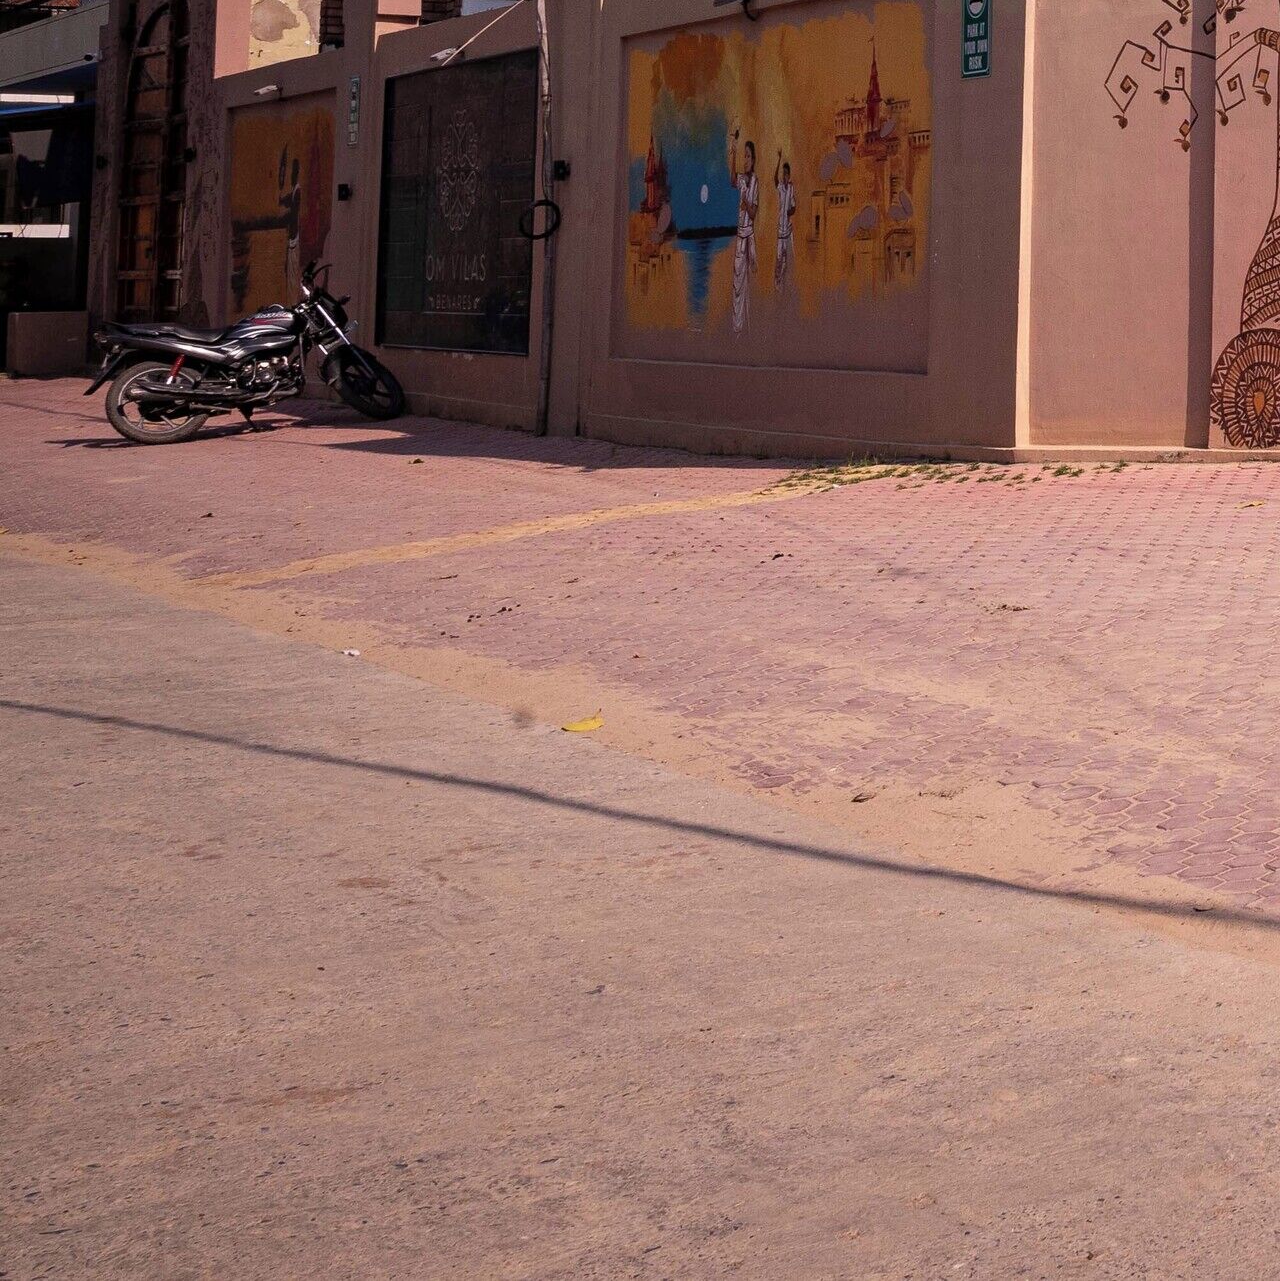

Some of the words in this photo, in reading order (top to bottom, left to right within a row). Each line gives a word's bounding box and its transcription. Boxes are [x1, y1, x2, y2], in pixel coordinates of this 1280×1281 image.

[969, 56, 982, 70] RISK
[425, 254, 445, 281] OM
[451, 253, 486, 282] VILAS
[436, 294, 472, 310] BENARES
